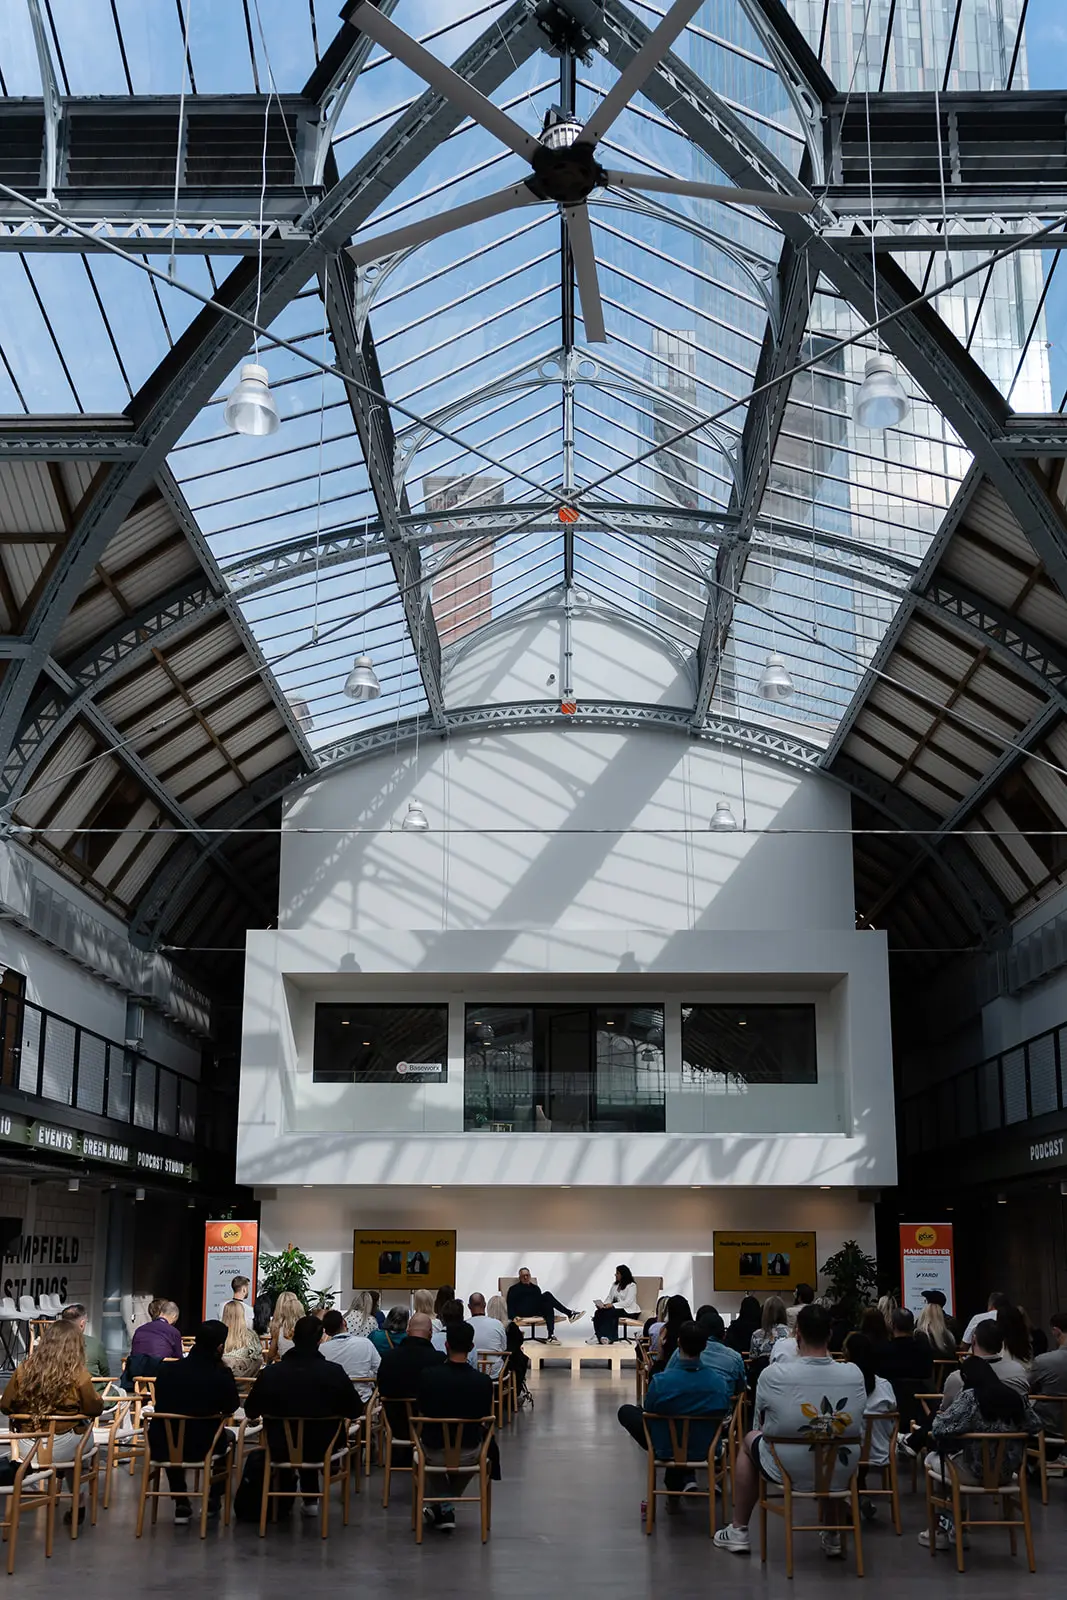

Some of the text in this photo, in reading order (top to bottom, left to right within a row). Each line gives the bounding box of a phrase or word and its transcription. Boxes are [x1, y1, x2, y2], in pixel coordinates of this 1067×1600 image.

[38, 1125, 73, 1150] EVENTS
[83, 1139, 129, 1162] GREEN ROOM
[1030, 1138, 1063, 1161] PODCAST
[137, 1151, 184, 1174] PODCAST STUDIO
